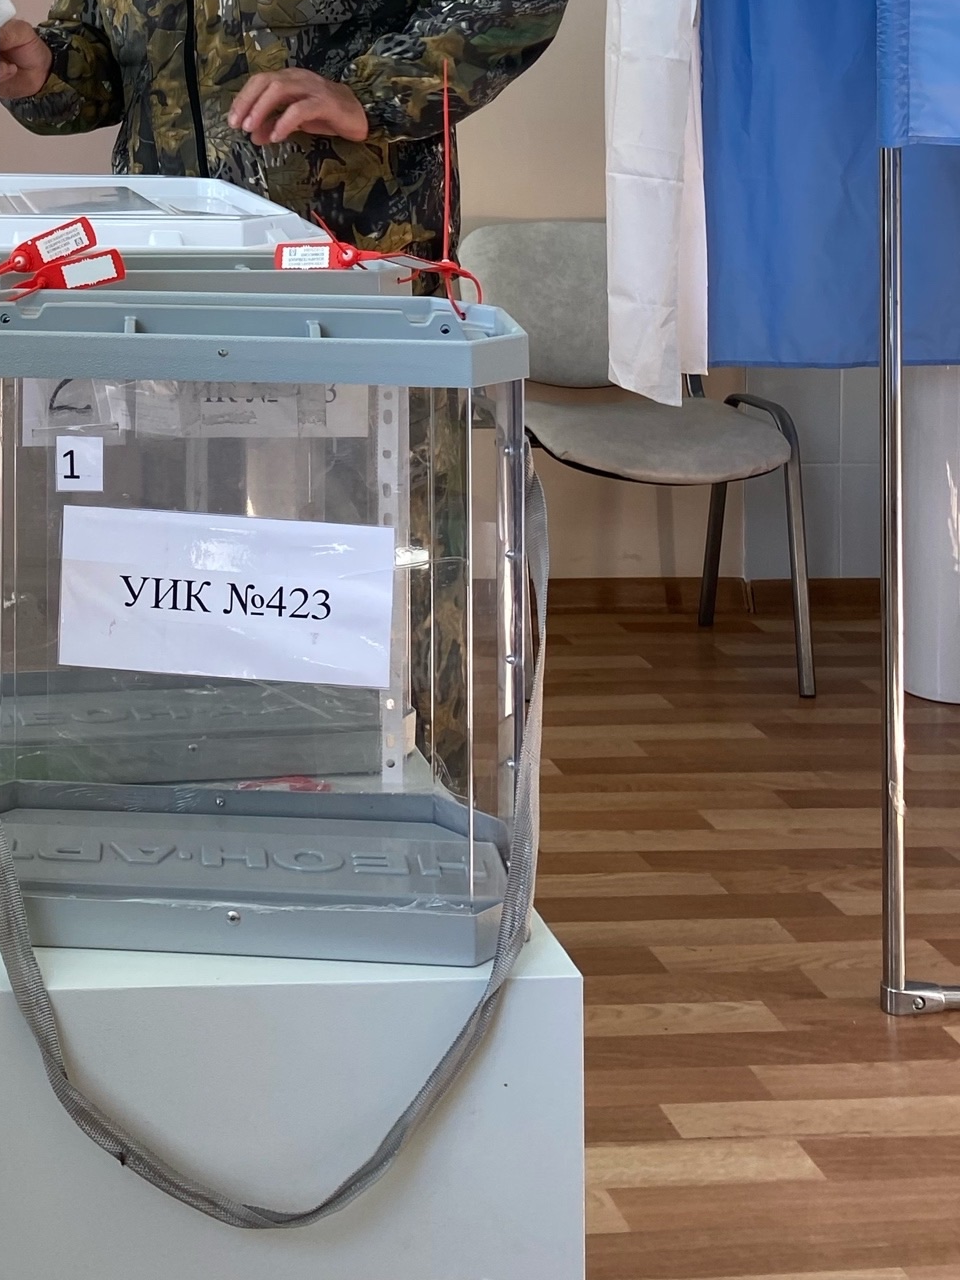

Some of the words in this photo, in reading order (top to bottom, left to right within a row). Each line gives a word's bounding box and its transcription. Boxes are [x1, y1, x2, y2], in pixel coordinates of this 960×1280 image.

[62, 450, 81, 480] 1
[119, 574, 212, 614] УИК
[222, 581, 333, 621] №423
